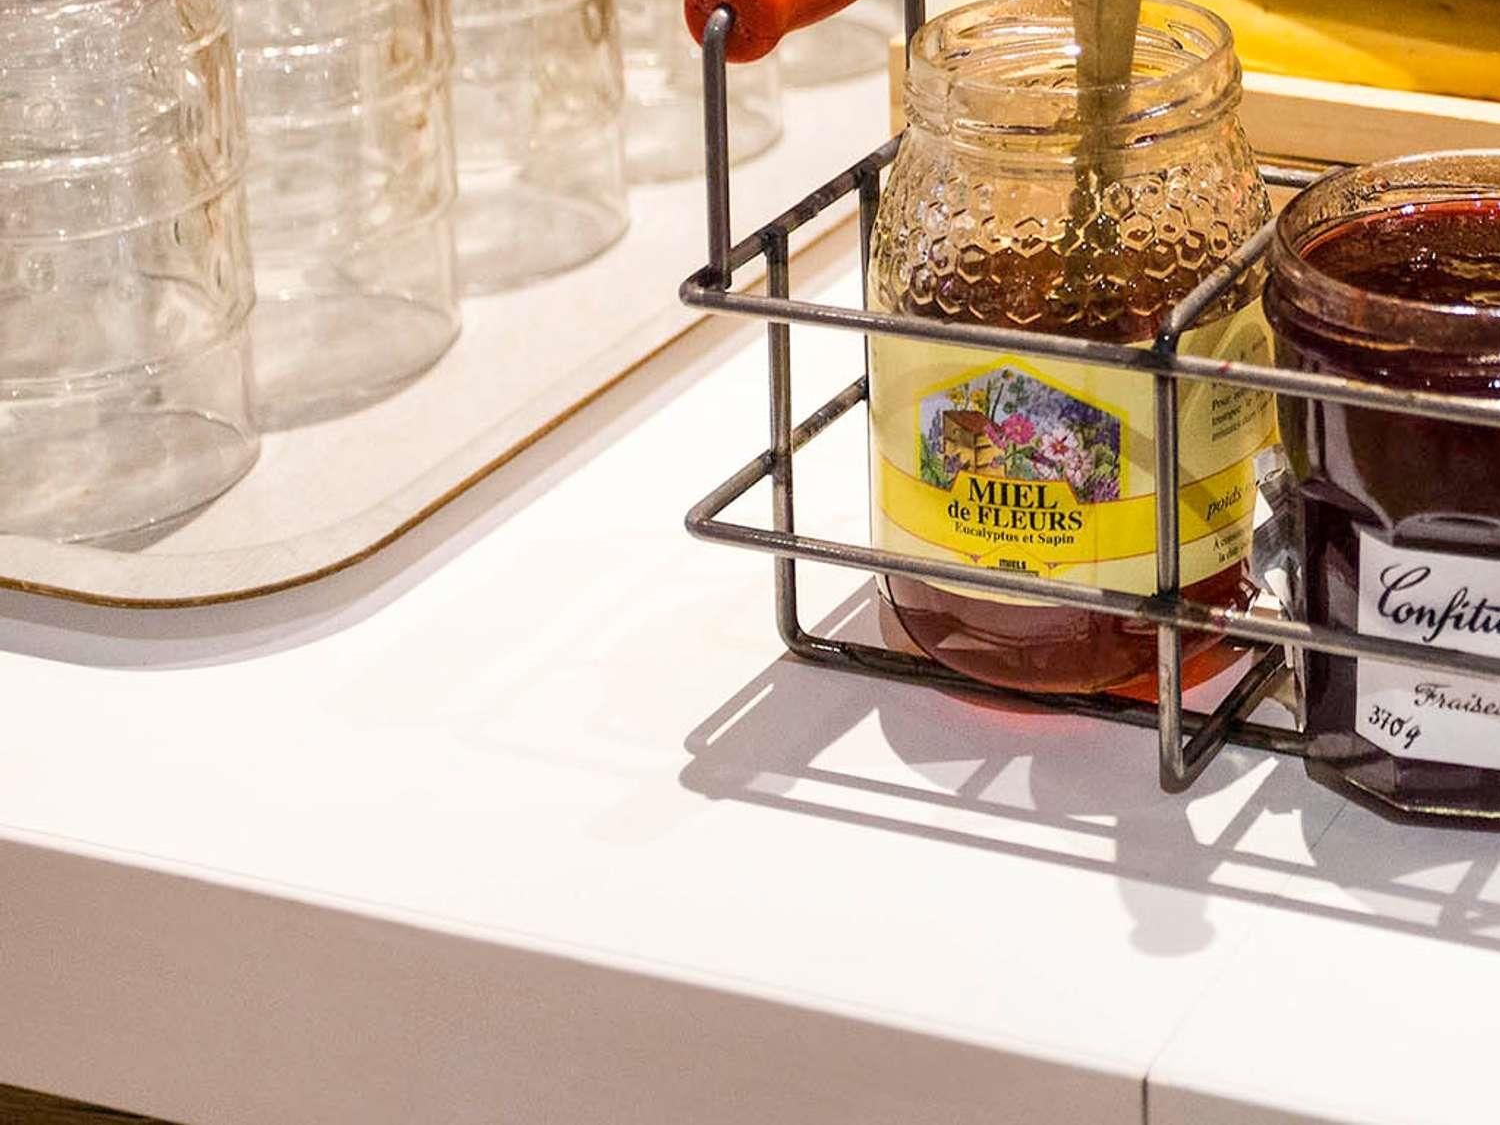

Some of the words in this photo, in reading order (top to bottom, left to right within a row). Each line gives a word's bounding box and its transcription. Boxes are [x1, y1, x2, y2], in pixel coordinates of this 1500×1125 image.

[968, 477, 1060, 511] MIEL
[948, 499, 971, 522] de
[977, 505, 1084, 532] FLEURS
[954, 521, 1020, 543] Eucalyptus
[1022, 532, 1034, 544] et
[1037, 533, 1075, 547] Sapin
